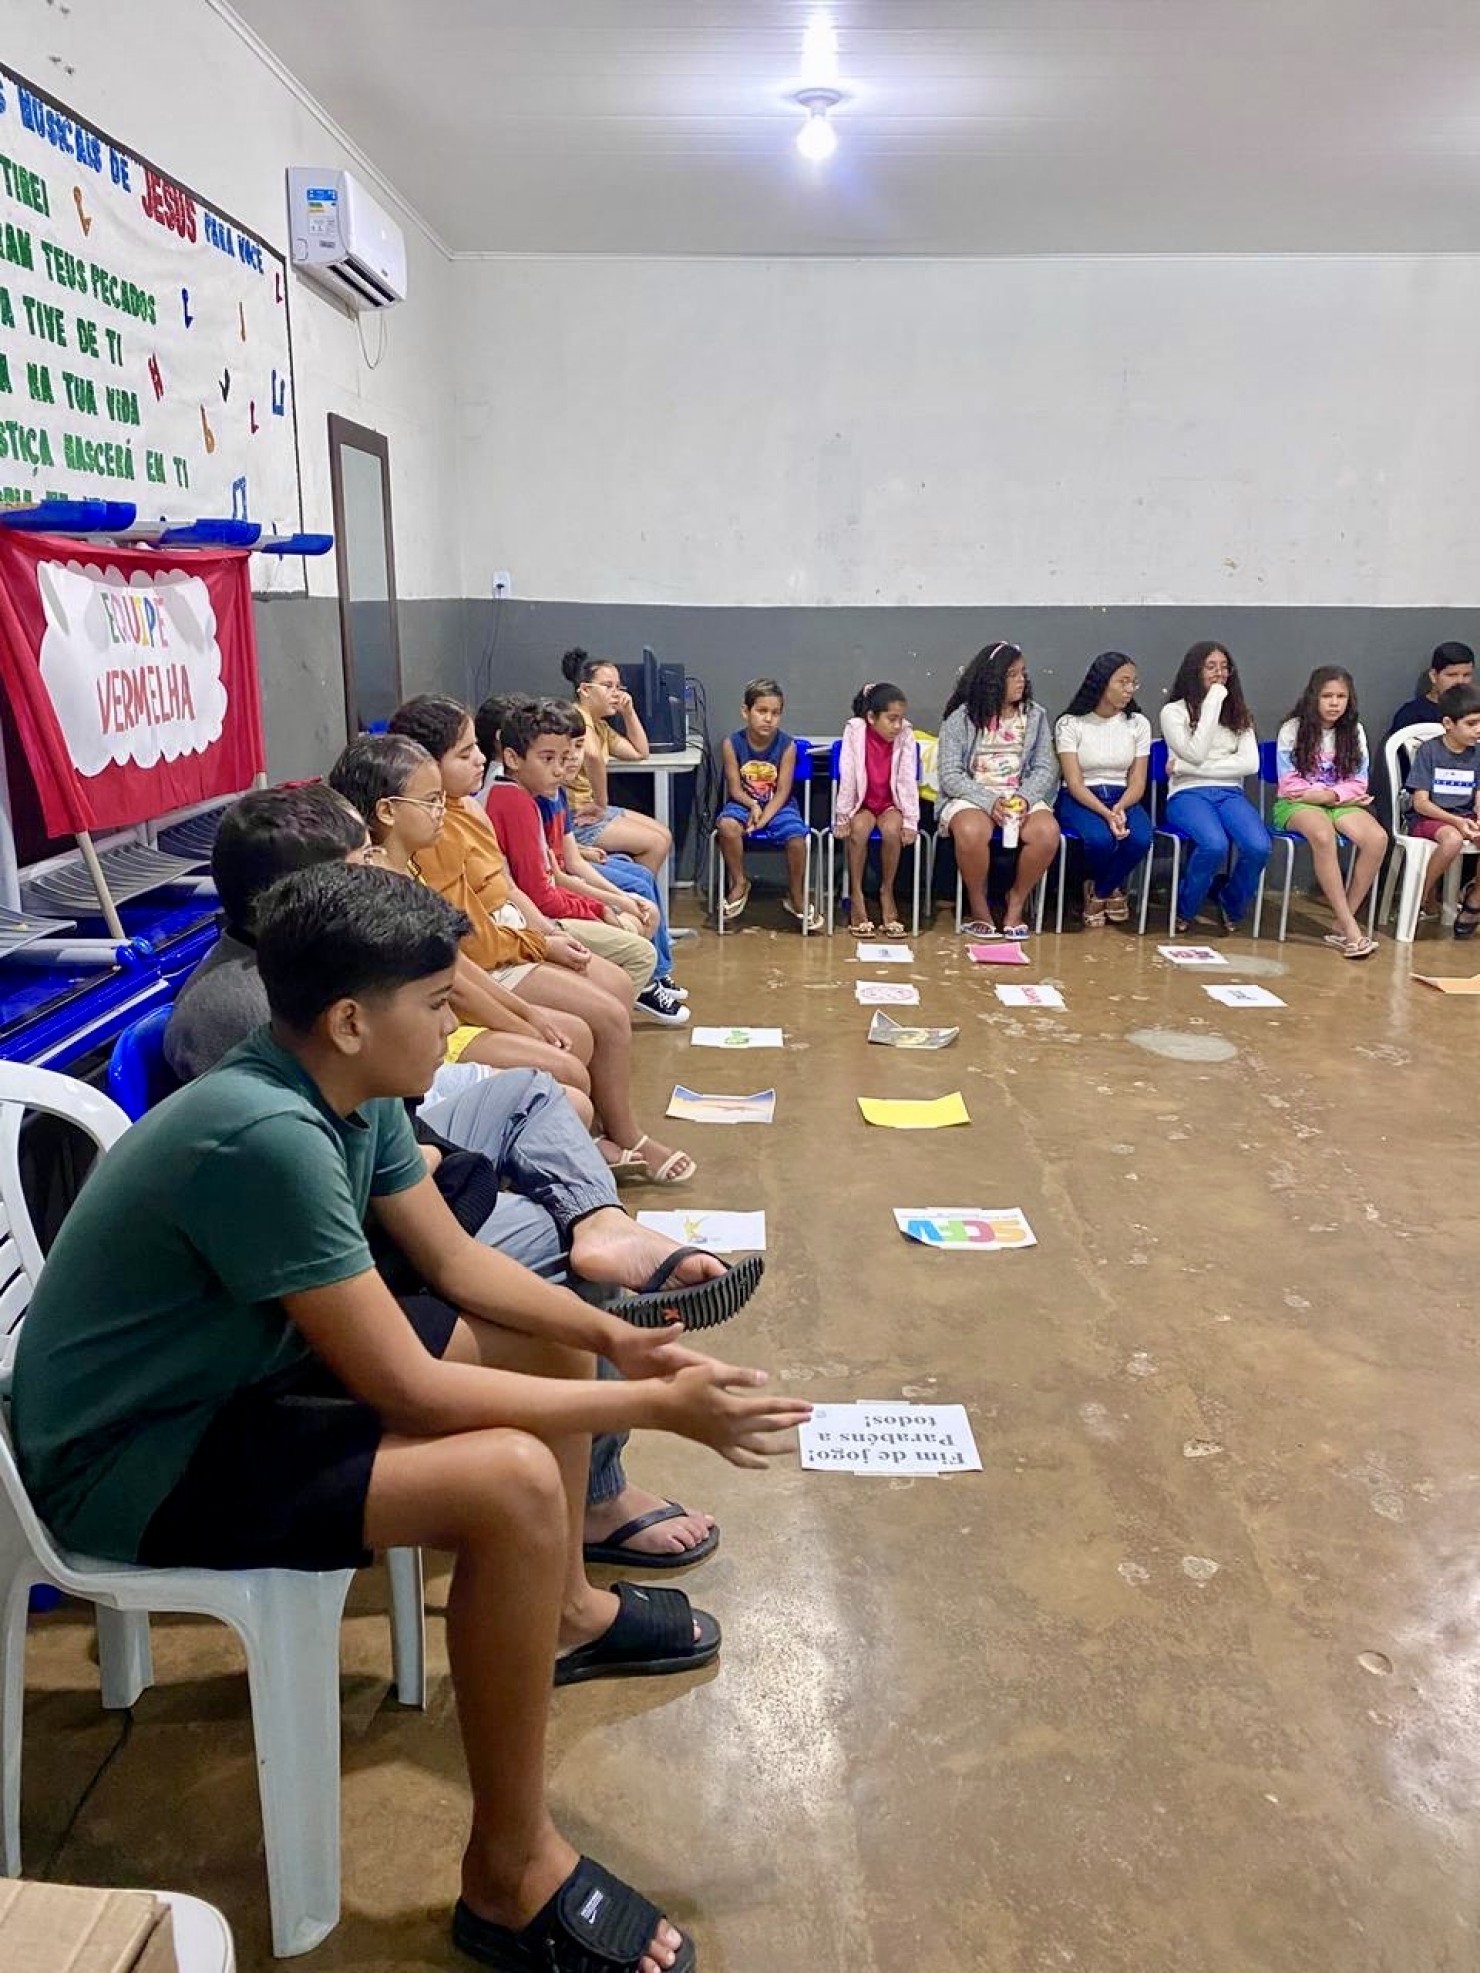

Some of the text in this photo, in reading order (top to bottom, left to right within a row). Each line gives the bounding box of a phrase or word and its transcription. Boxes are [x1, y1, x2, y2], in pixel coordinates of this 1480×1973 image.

[0, 153, 50, 217] TIREI
[17, 84, 102, 173] MUSICAIS
[109, 147, 131, 193] DE
[142, 167, 196, 243] JESUS
[204, 211, 235, 257] PARA
[237, 233, 264, 274] VOCÊ
[41, 240, 88, 294] TEUS
[90, 263, 157, 325] PECADOS
[22, 295, 67, 347] TIVE
[77, 317, 99, 358] DE
[105, 327, 123, 367] TI
[27, 361, 54, 404] NA
[62, 371, 98, 415] TUA
[106, 385, 140, 425] VIDA
[63, 433, 135, 480] NASCERÁ
[146, 450, 165, 483] EM
[173, 456, 188, 489] TI
[100, 592, 169, 648] EQUIPE
[96, 663, 196, 735] VERMELHA
[907, 1220, 1027, 1242] SCFV
[817, 1432, 955, 1447] Parabéns a
[864, 1415, 937, 1427] todos!
[808, 1448, 965, 1465] Fim de jogo!
